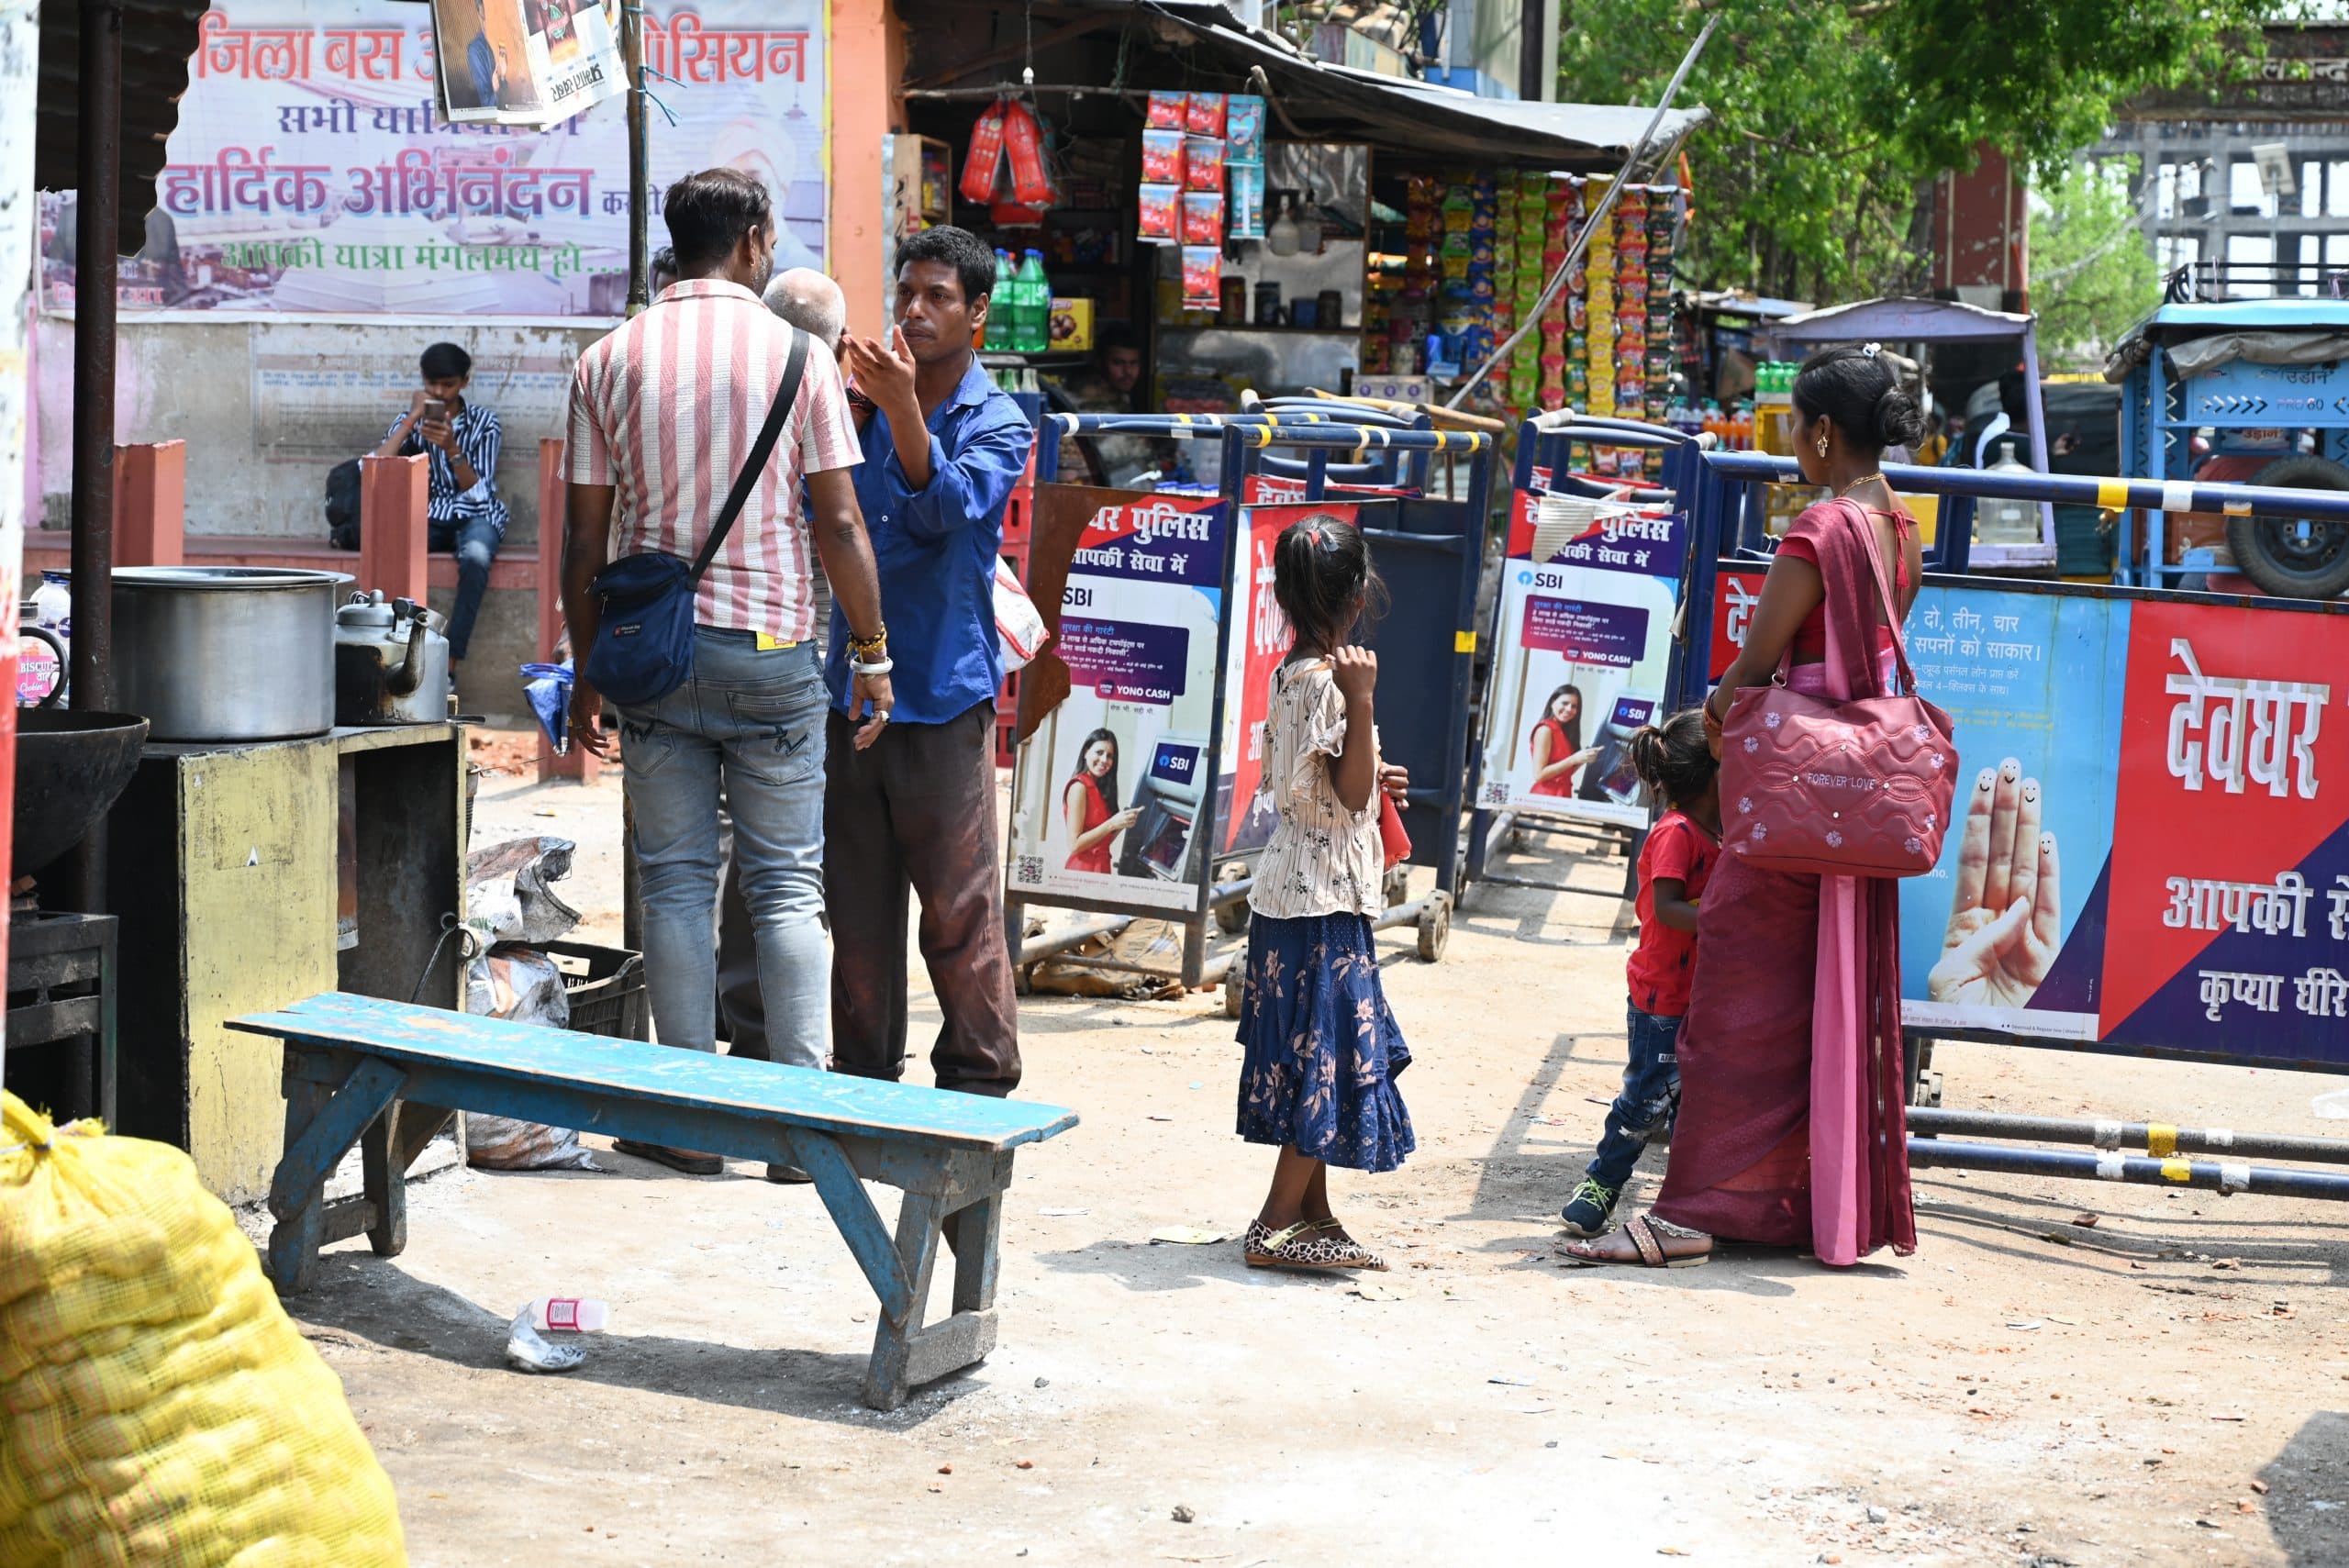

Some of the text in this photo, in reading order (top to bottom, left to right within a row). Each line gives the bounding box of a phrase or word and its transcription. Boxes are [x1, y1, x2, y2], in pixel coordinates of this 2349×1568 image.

[196, 11, 316, 81] जिला
[323, 29, 406, 81] बस
[277, 97, 359, 133] सभी
[163, 146, 331, 215] हार्दिक
[343, 147, 596, 217] अभिनंदन
[221, 236, 325, 270] आपकी
[335, 244, 405, 270] यात्रा
[416, 238, 540, 272] मंगलमय
[1130, 502, 1213, 544] पुलिस
[1130, 550, 1165, 573] सेवा
[1170, 552, 1189, 575] में
[1598, 545, 1630, 565] सेवा
[1634, 550, 1651, 567] में
[1535, 573, 1563, 589] SBI
[1063, 586, 1093, 606] SBI
[1924, 605, 1944, 631] दो,
[1953, 606, 1986, 634] तीन,
[1993, 616, 2020, 633] चार
[1583, 651, 1607, 662] YONO
[1608, 653, 1631, 664] CASH
[1915, 632, 1955, 655] सपनों
[1960, 635, 1981, 658] को
[1987, 641, 2041, 662] साकार।
[1117, 684, 1144, 697] YONO
[1145, 688, 1171, 700] CASH
[1628, 707, 1646, 720] SBI
[2165, 638, 2331, 800] देवघर
[1169, 756, 1190, 772] SBI
[1807, 773, 1876, 791] FOREVER LOVE
[2163, 871, 2314, 938] आपकी
[2199, 970, 2285, 1022] कृप्या
